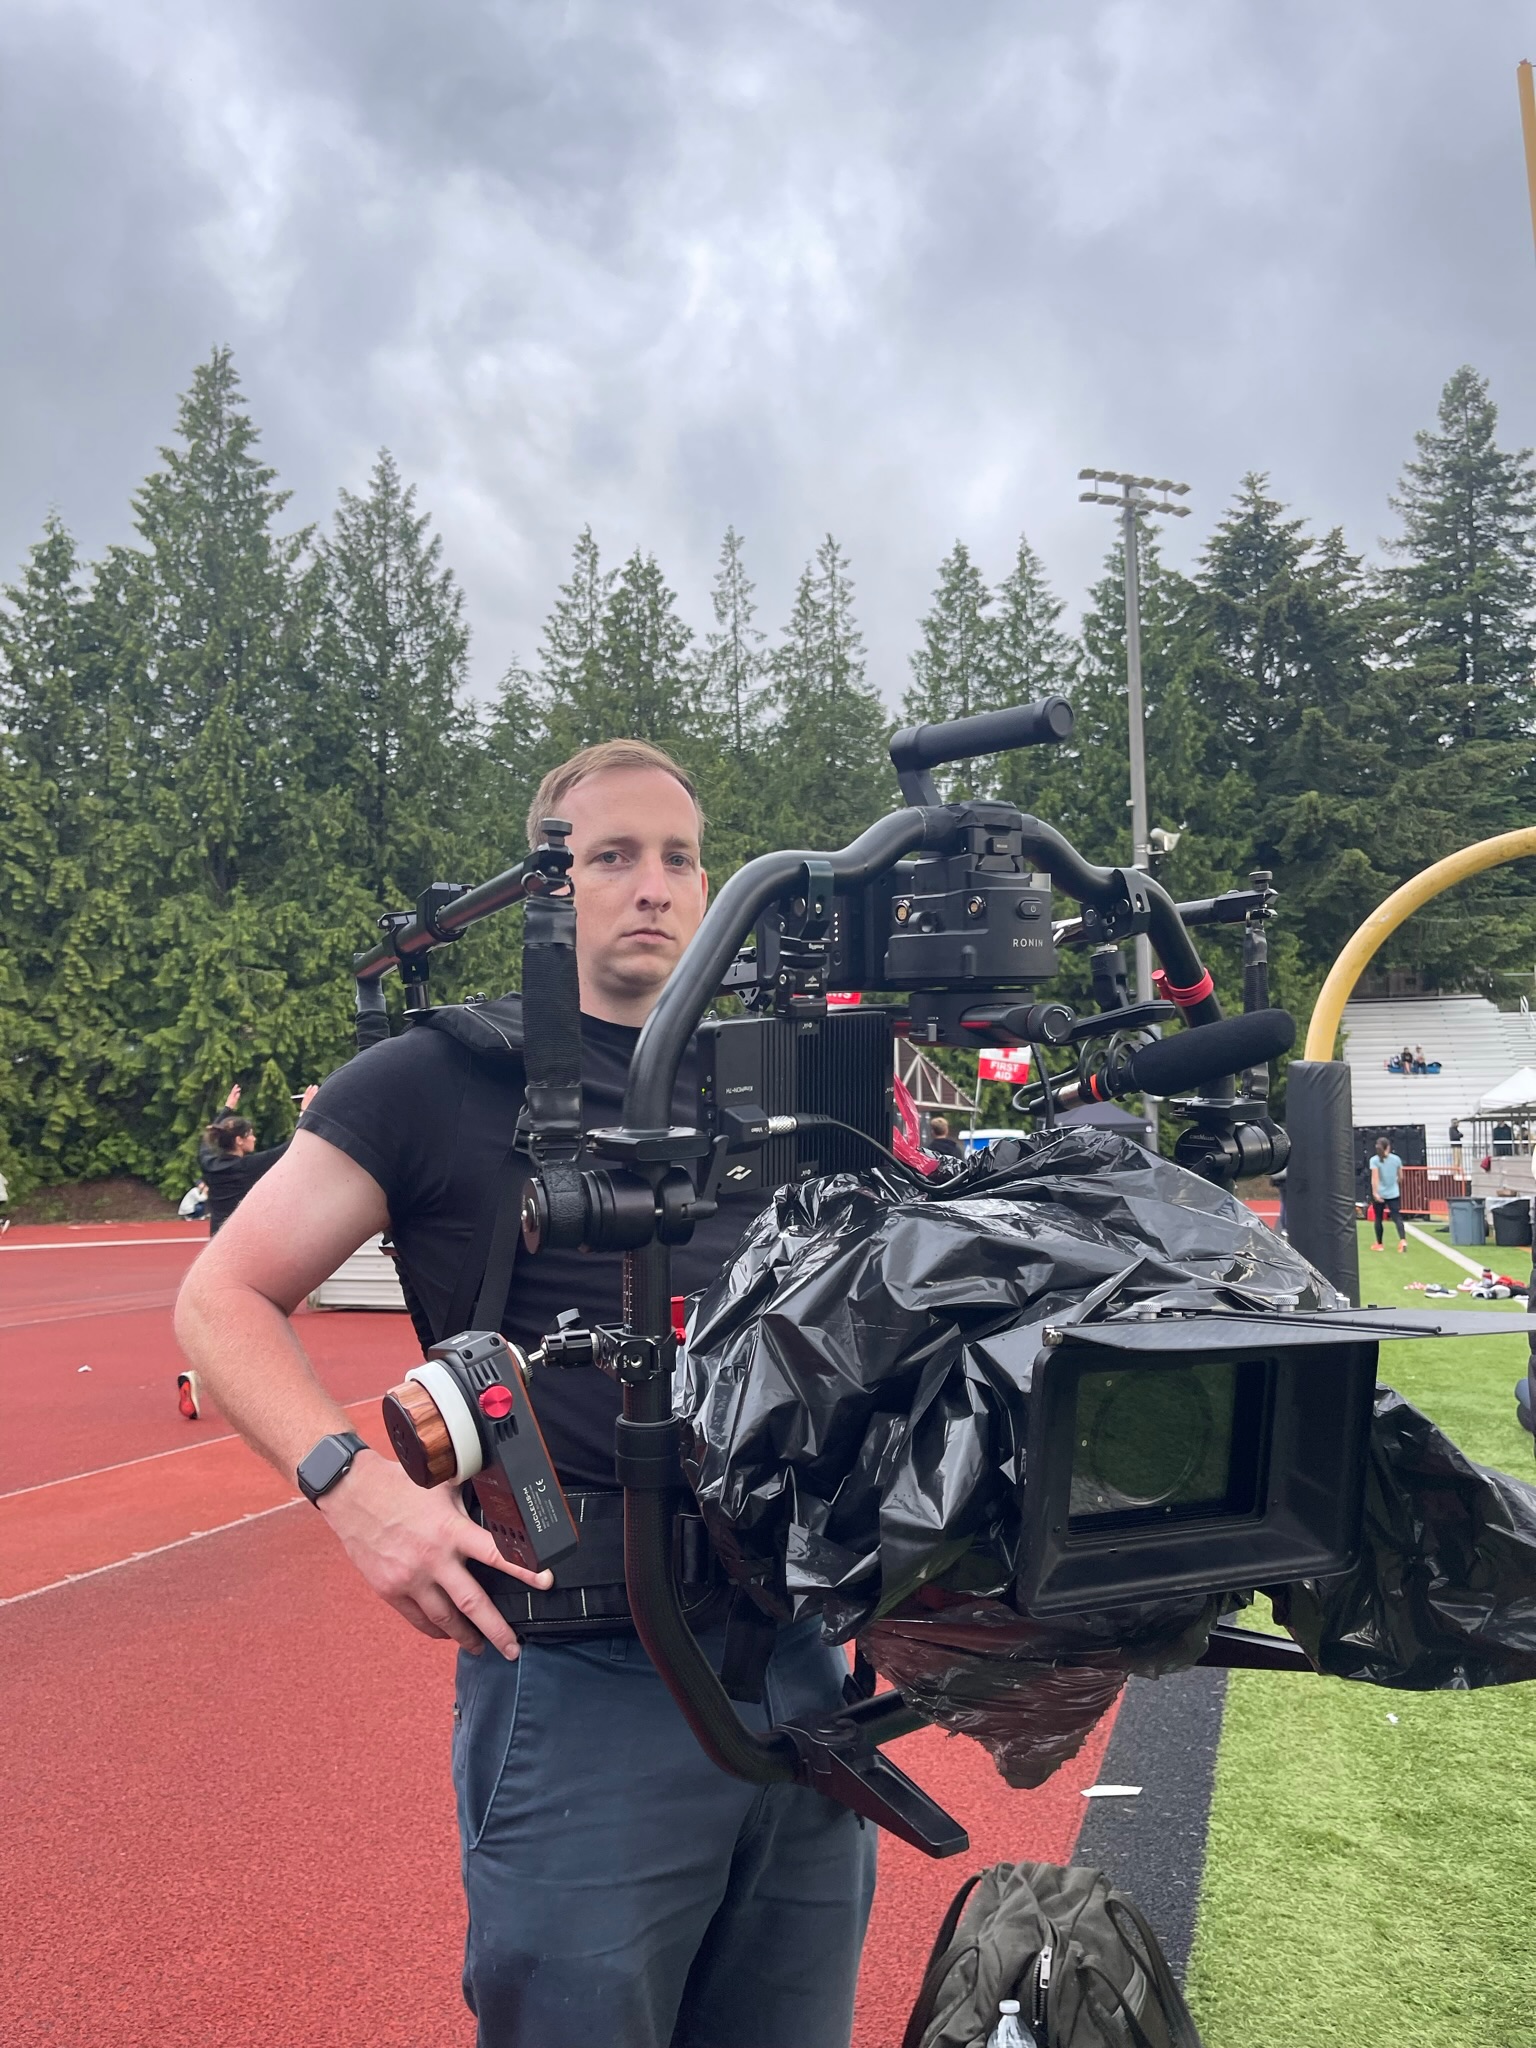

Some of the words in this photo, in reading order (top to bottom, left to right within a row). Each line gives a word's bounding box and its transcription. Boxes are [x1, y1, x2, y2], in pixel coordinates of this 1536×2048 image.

[1012, 938, 1044, 948] RONIN
[990, 1060, 1019, 1073] FIRST
[993, 1070, 1013, 1081] AID
[522, 1486, 543, 1533] NUCLEUS-M
